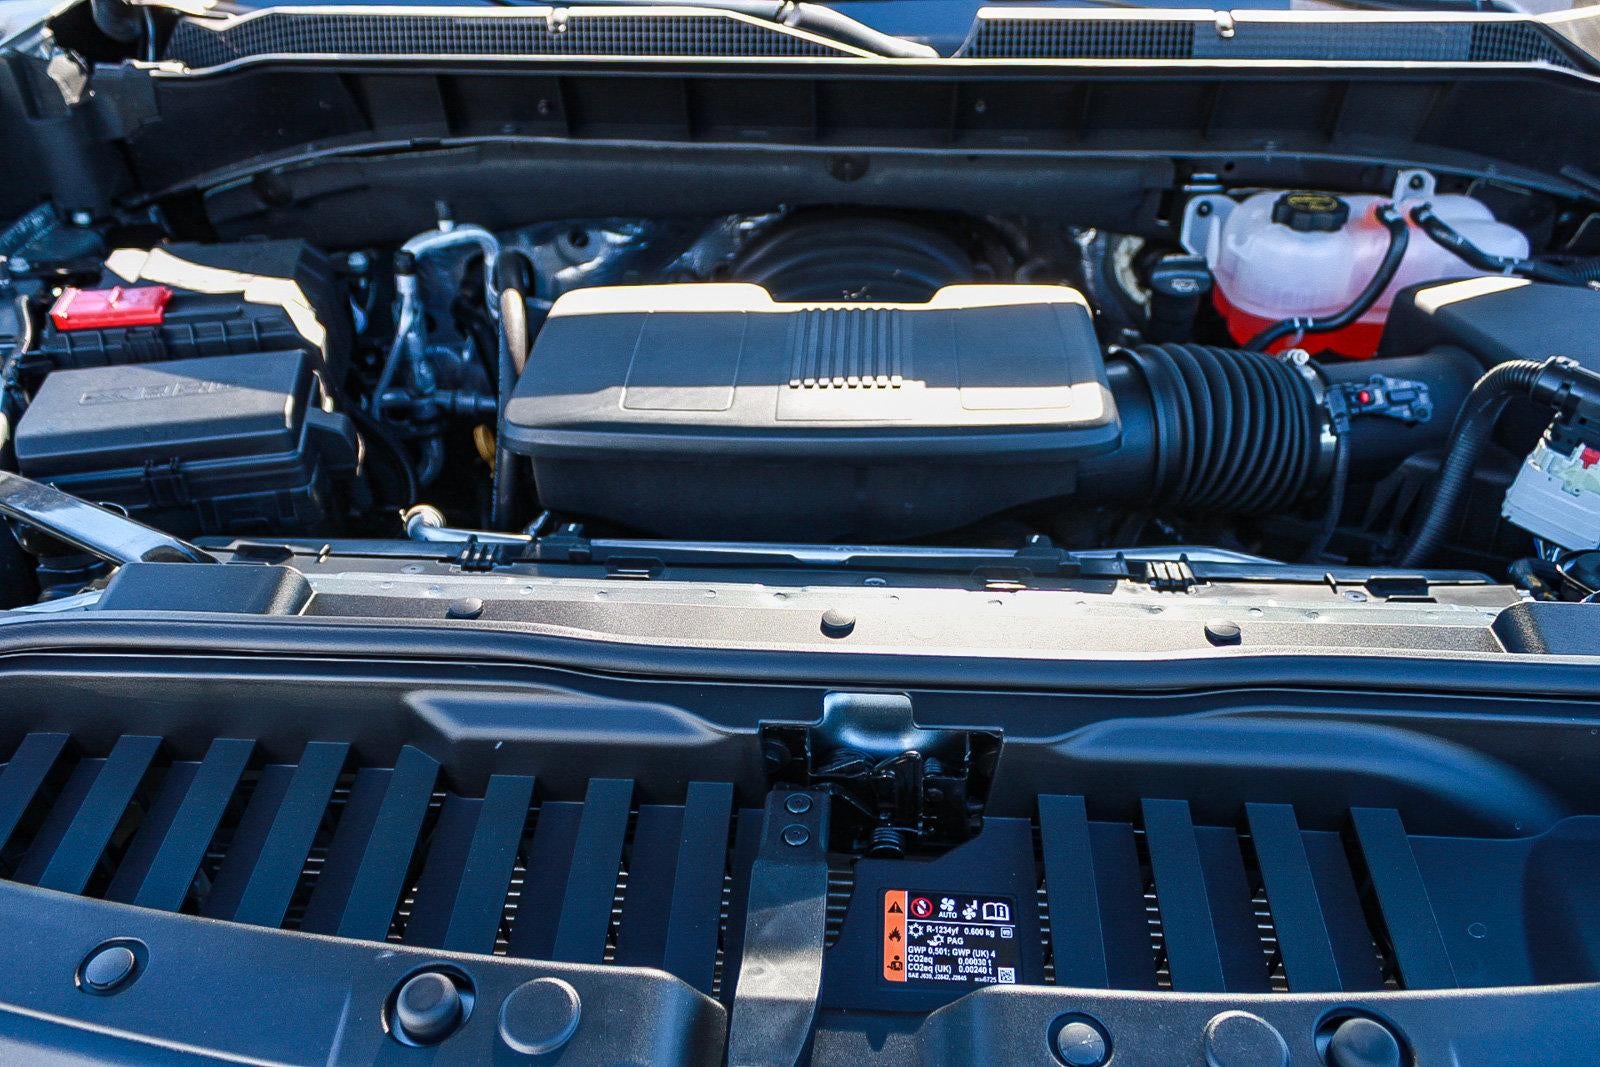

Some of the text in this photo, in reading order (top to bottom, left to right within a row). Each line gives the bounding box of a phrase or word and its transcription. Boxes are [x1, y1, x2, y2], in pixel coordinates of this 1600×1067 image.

[926, 925, 959, 936] R-1234yf
[985, 928, 995, 938] kg
[946, 936, 964, 945] PAG
[908, 946, 926, 954] GWP
[952, 948, 971, 958] GWP
[972, 949, 989, 959] (UK)
[990, 950, 996, 958] 4
[908, 954, 933, 964] CO2eq
[988, 959, 992, 967] t
[908, 963, 933, 973] CO2eq
[934, 965, 952, 974] (UK)
[988, 967, 992, 975] t
